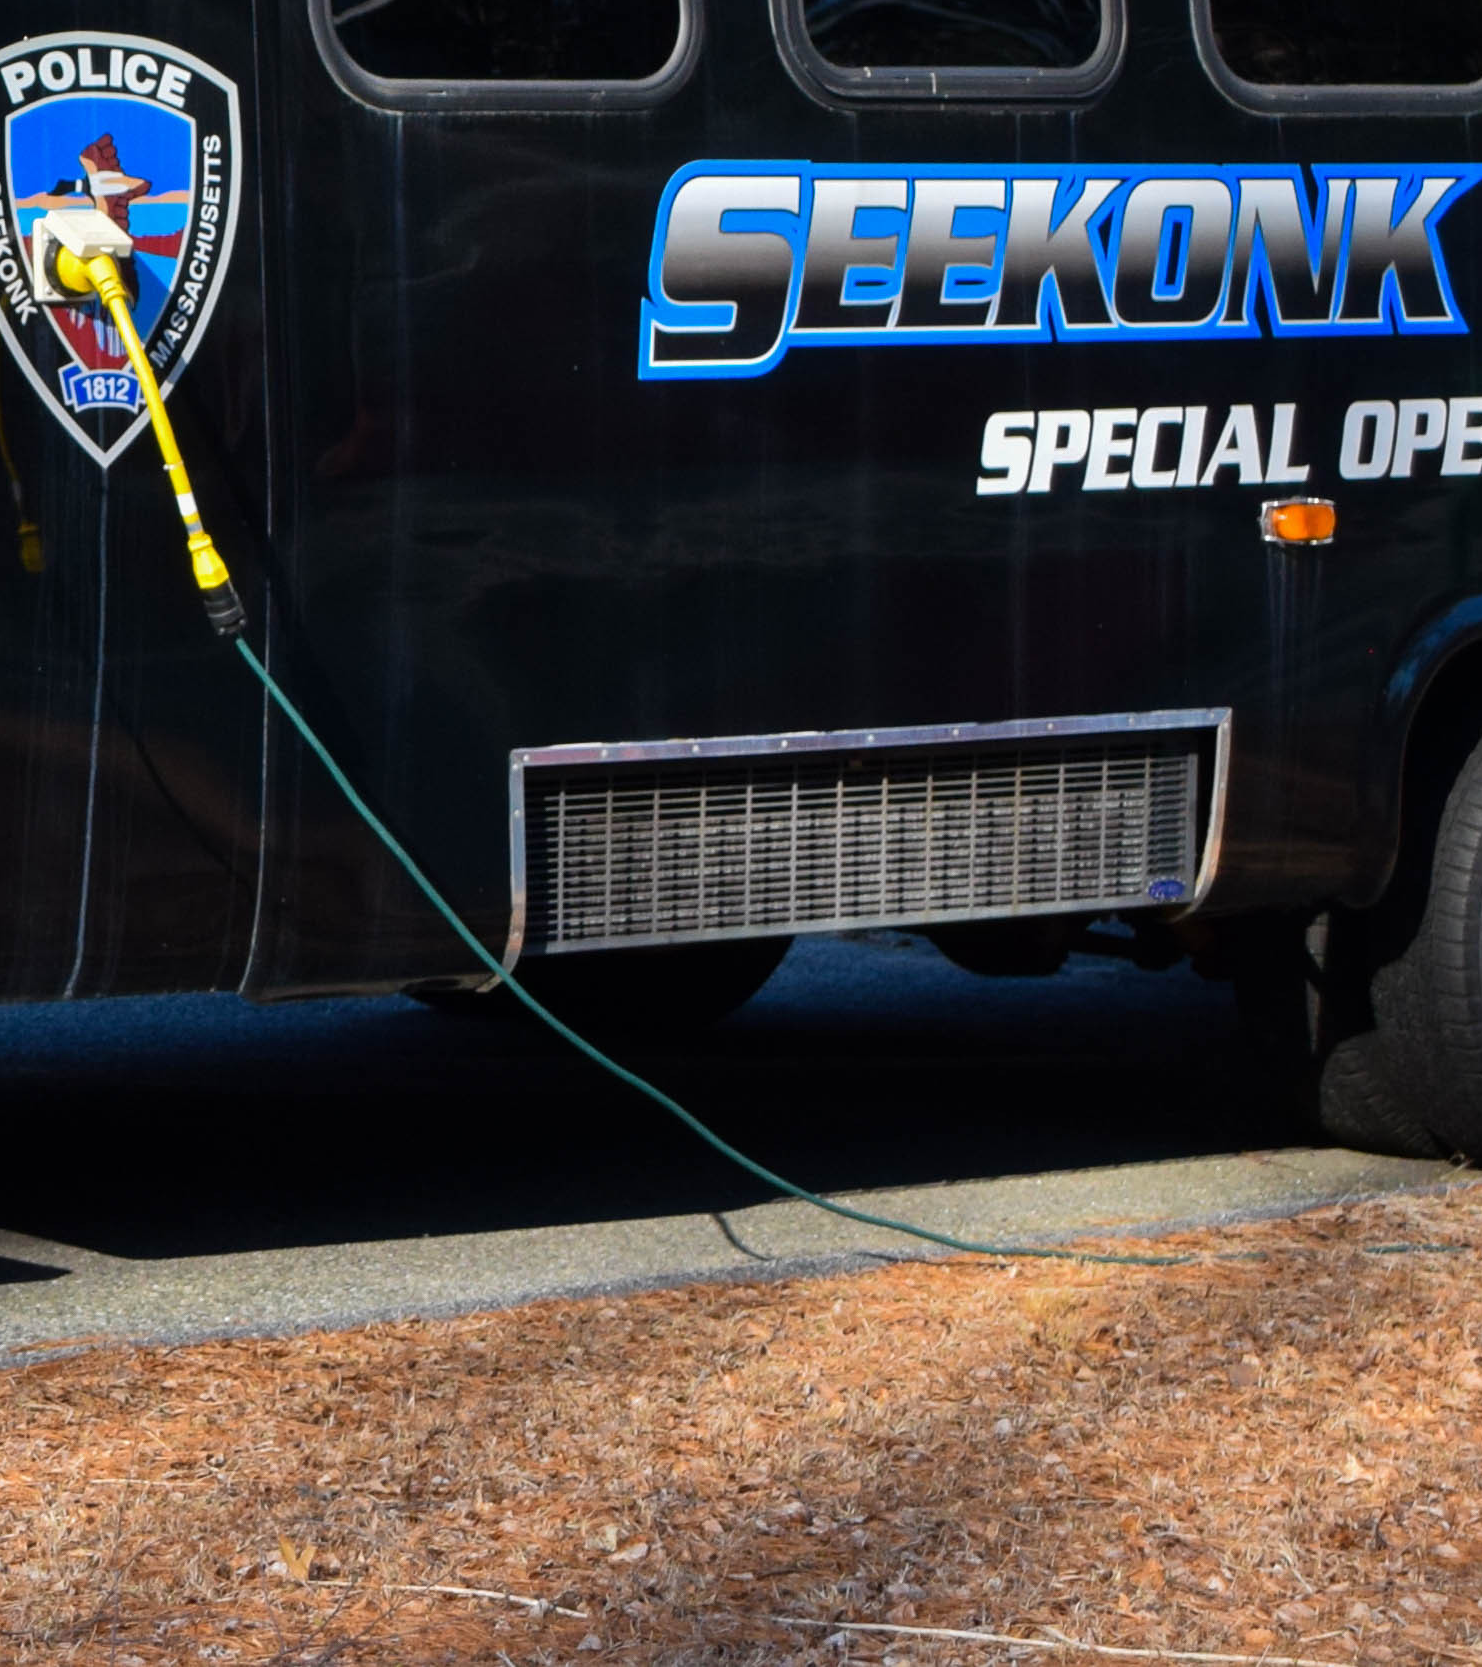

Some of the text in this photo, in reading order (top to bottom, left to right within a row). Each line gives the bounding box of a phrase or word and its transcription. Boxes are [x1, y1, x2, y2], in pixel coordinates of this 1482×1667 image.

[0, 48, 192, 108] POLICE
[149, 134, 221, 369] MASSACHUSETTS
[81, 377, 130, 402] 1812
[976, 403, 1309, 495] SPECIAL
